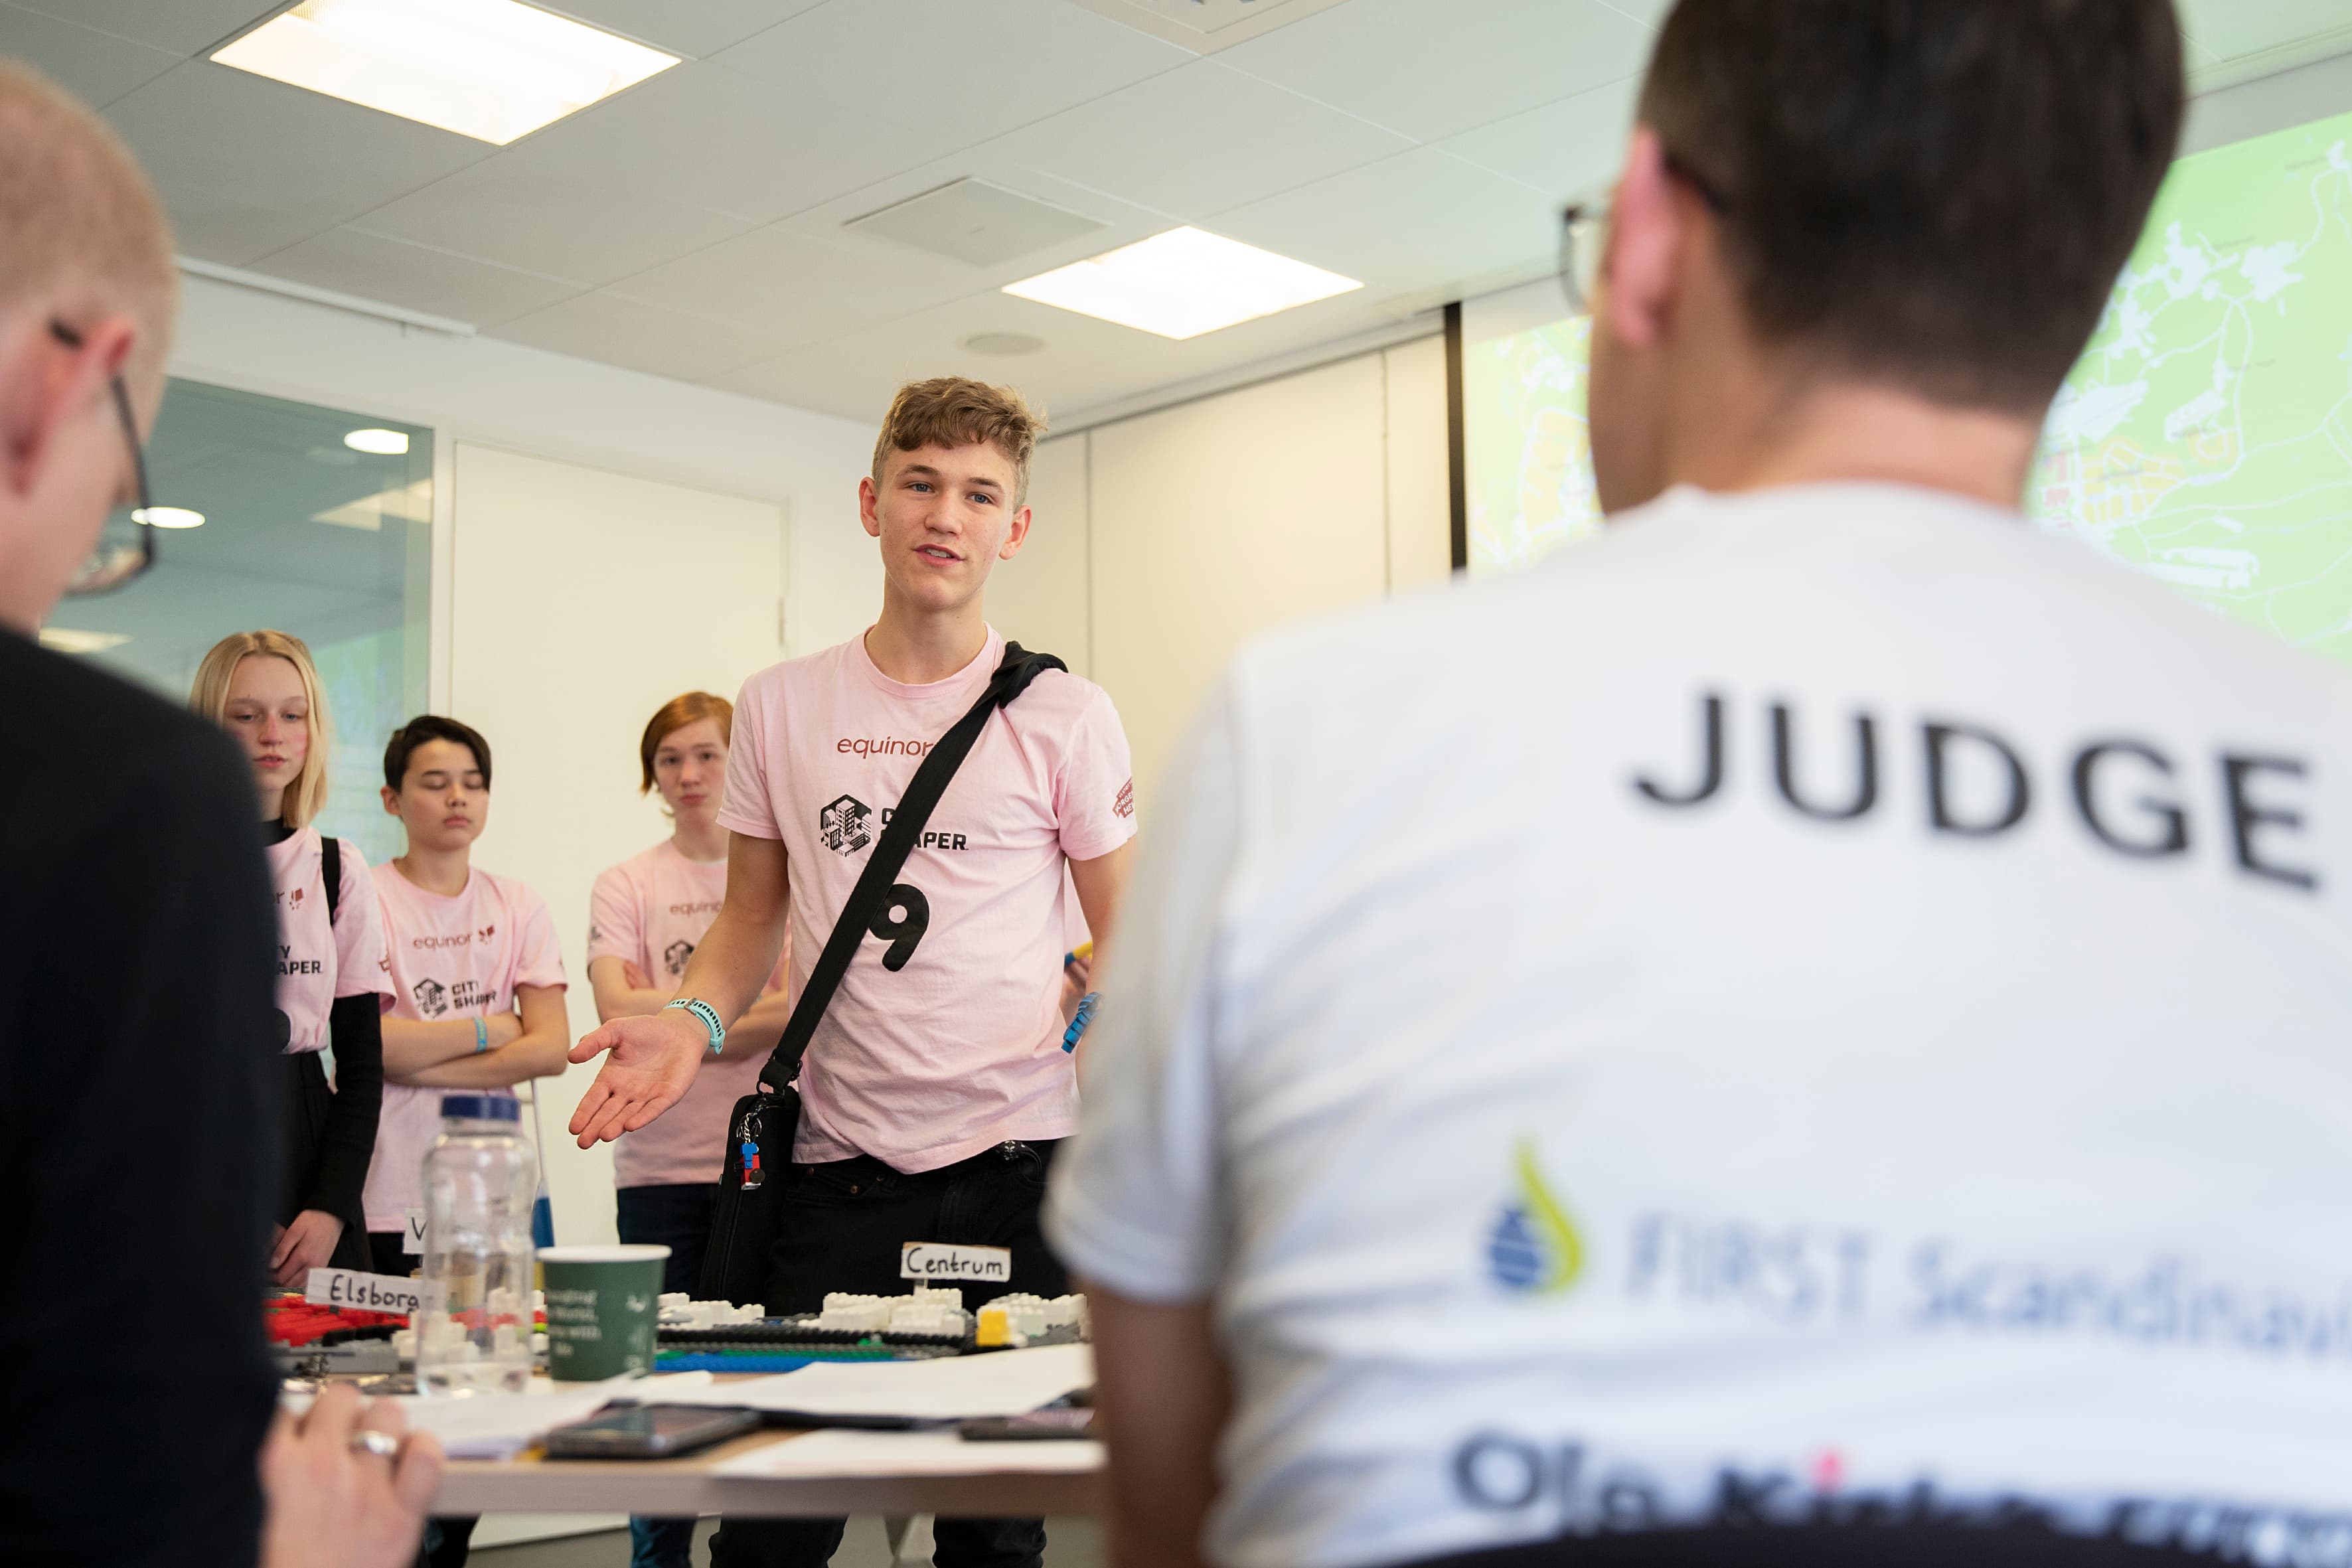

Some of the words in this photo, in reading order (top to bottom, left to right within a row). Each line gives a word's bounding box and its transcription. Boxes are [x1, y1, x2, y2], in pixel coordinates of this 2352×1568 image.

[837, 736, 933, 759] equinor
[1630, 689, 2321, 892] JUDGE
[669, 902, 724, 918] equino
[870, 884, 929, 972] 9
[413, 933, 472, 951] equinor
[278, 961, 321, 975] APER
[907, 1247, 1002, 1275] Centrum
[1626, 1211, 1871, 1320] FIRST
